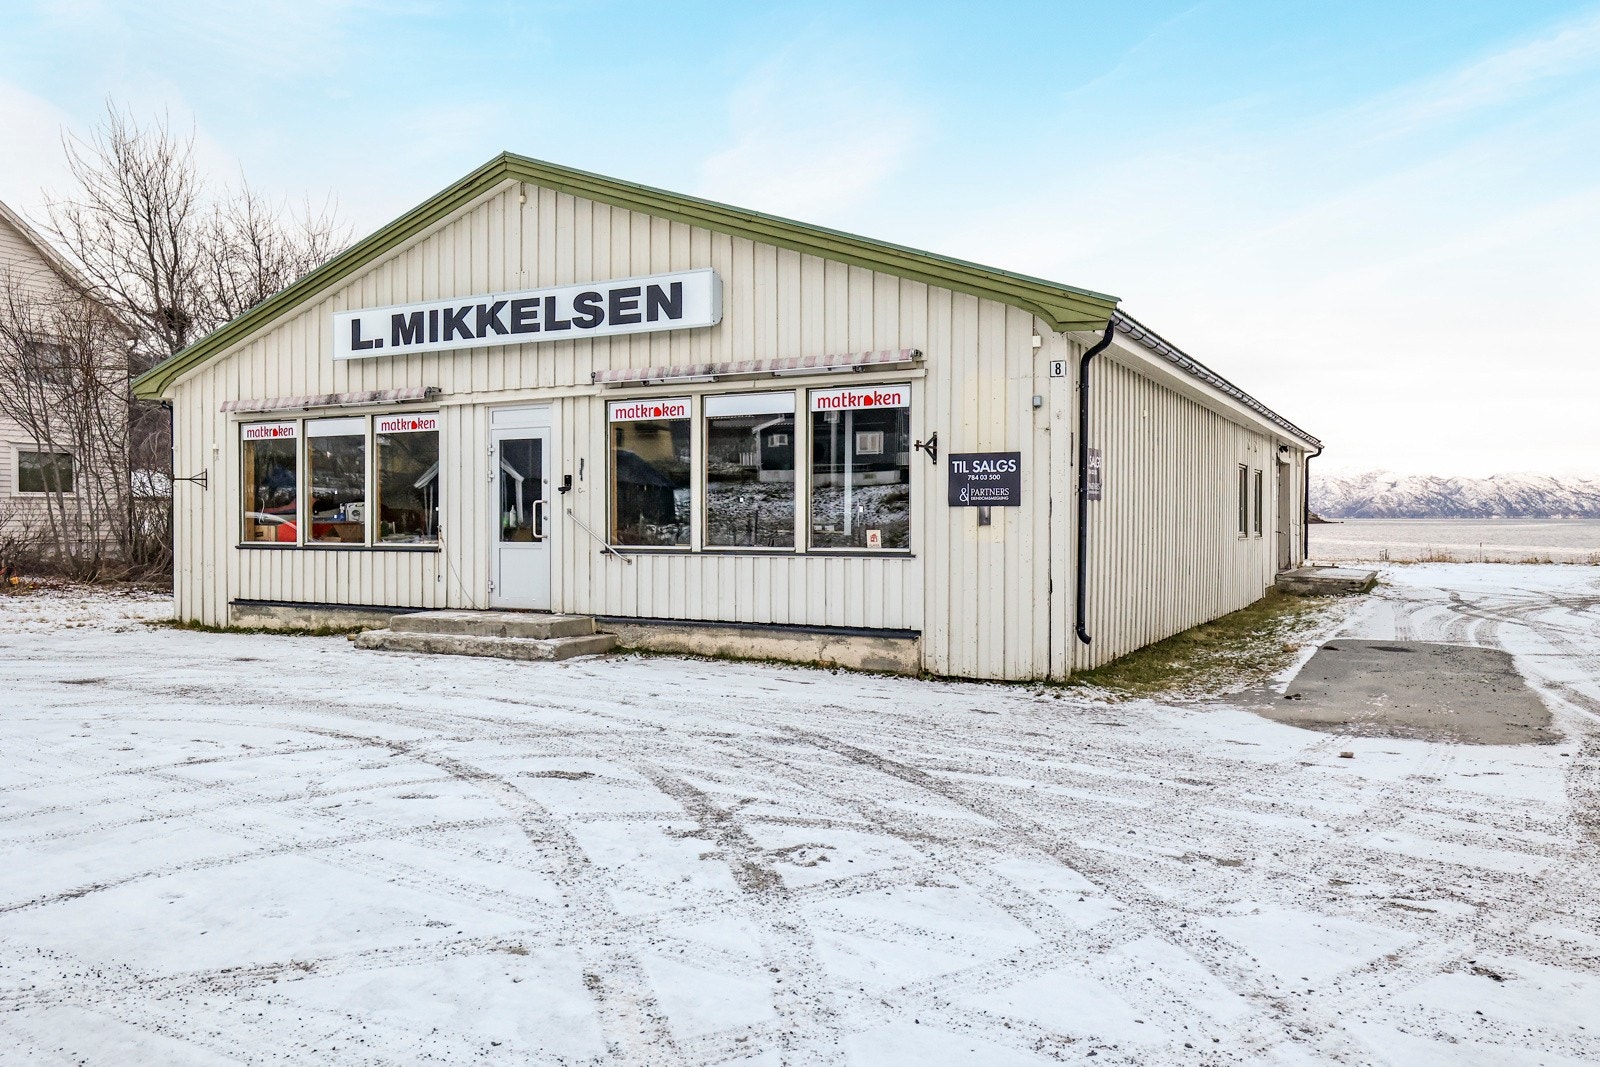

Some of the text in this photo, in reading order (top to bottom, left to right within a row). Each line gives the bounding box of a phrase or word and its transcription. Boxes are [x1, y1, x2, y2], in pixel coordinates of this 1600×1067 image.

[350, 281, 683, 351] L. MIKKELSEN
[1055, 362, 1061, 375] 8
[817, 390, 901, 409] matkroken
[615, 402, 685, 420] matkroken
[952, 459, 1017, 474] TIL SALGS
[970, 487, 1010, 496] PARTNERS
